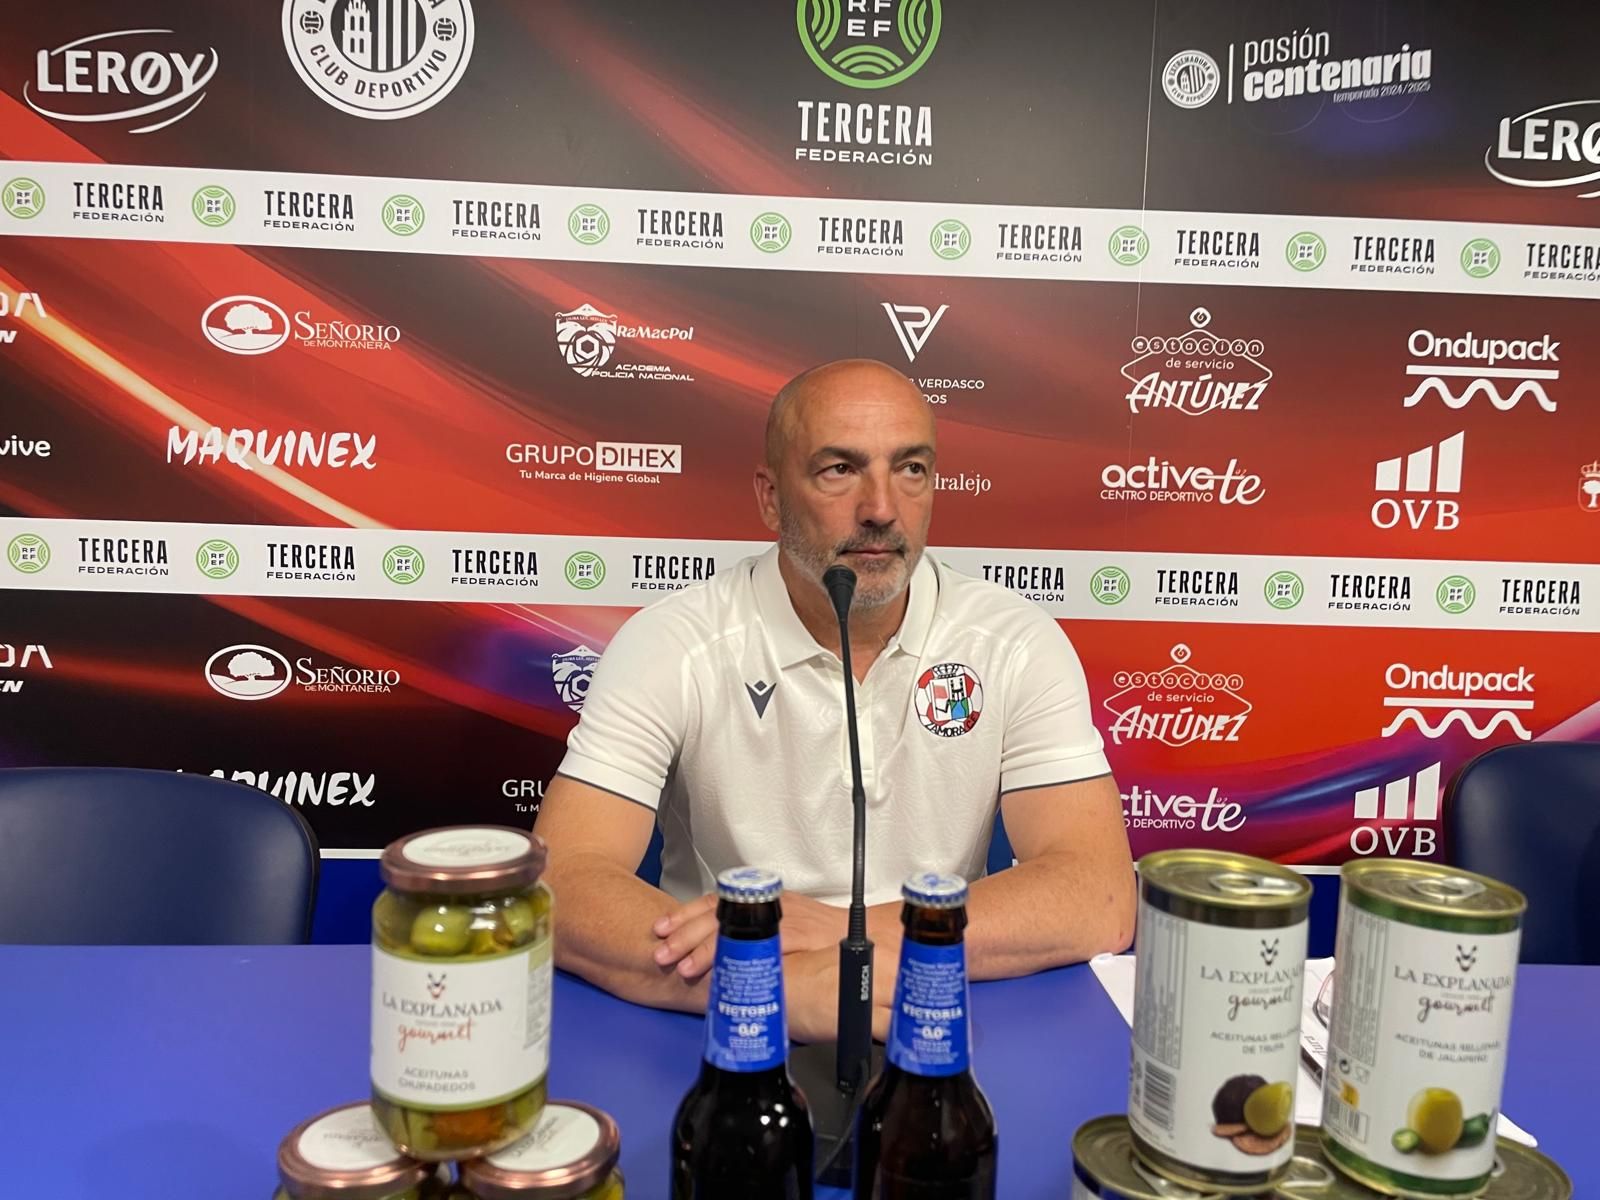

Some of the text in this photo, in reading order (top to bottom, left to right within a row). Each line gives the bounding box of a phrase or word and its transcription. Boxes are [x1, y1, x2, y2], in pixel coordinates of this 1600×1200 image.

[847, 19, 892, 38] EF
[1244, 27, 1329, 71] pasión
[310, 44, 447, 98] CLUB DEPORTIVO
[1244, 43, 1432, 101] centenaria
[798, 100, 932, 146] TERCERA
[795, 148, 932, 166] FEDERACIÓN
[73, 182, 163, 211] TERCERA
[264, 190, 353, 220] TERCERA
[73, 212, 164, 222] FEDERACIÓN
[453, 200, 540, 228] TERCERA
[638, 209, 723, 237] TERCERA
[264, 220, 354, 232] FEDERACIÓN
[452, 229, 540, 240] FEDERACIÓN
[819, 217, 903, 244] TERCERA
[637, 238, 723, 249] FEDERACIÓN
[998, 224, 1081, 250] TERCERA
[1177, 230, 1259, 257] TERCERA
[818, 246, 903, 256] FEDERACIÓN
[997, 253, 1082, 262] FEDERACIÓN
[1354, 236, 1434, 263] TERCERA
[1174, 258, 1259, 268] FEDERACIÓN
[1351, 264, 1434, 274] FEDERACIÓN
[1524, 270, 1600, 282] FEDERACIÓ
[616, 325, 694, 341] RaMacPol
[316, 340, 392, 350] MONTANERA
[1408, 330, 1560, 366] Ondupack
[615, 364, 671, 372] ACADEMIA
[1165, 357, 1234, 371] de servicio
[638, 372, 694, 381] NACIONAL
[918, 378, 984, 390] VERDASCO
[1125, 372, 1268, 413] ANTÚNEZ
[167, 425, 376, 470] MAQUINEX
[506, 442, 676, 468] GRUPO DIHEX
[520, 470, 660, 484] Tu Marca de Higiene Global
[1100, 490, 1214, 502] CENTRO DEPORTIVO
[1370, 498, 1460, 530] OVB
[78, 538, 168, 564] TERCERA
[267, 543, 355, 570] TERCERA
[78, 566, 168, 576] FEDERACIÓN
[452, 549, 538, 576] TERCERA
[632, 555, 715, 580] TERCERA
[266, 572, 355, 581] FEDERACIÓN
[451, 576, 538, 586] FEDERACIÓN
[982, 565, 1064, 590] TERCERA
[1157, 570, 1238, 595] TERCERA
[1330, 574, 1410, 600] TERCERA
[1502, 579, 1580, 604] TERCERA
[1019, 592, 1064, 602] ACIÓN
[1155, 596, 1238, 606] FEDERACIÓN
[1328, 602, 1410, 611] FEDERACIÓN
[1499, 606, 1580, 615] FEDERACIÓN
[317, 684, 391, 692] MONTANERA
[1384, 663, 1534, 696] Ondupack
[1147, 692, 1214, 704] de servicio
[925, 724, 966, 737] ZAMORA
[1108, 706, 1248, 745] ANTÚNEZ
[514, 804, 526, 812] Tu
[1134, 818, 1196, 829] DEPORTIVO
[1350, 826, 1437, 856] OVB
[860, 964, 870, 1001] BOSCH
[1200, 965, 1222, 982] LA
[1394, 965, 1417, 984] LA
[382, 992, 502, 1018] LA EXPLANADA
[718, 1000, 779, 1018] VICTORIA
[902, 1002, 962, 1020] VICTORIA
